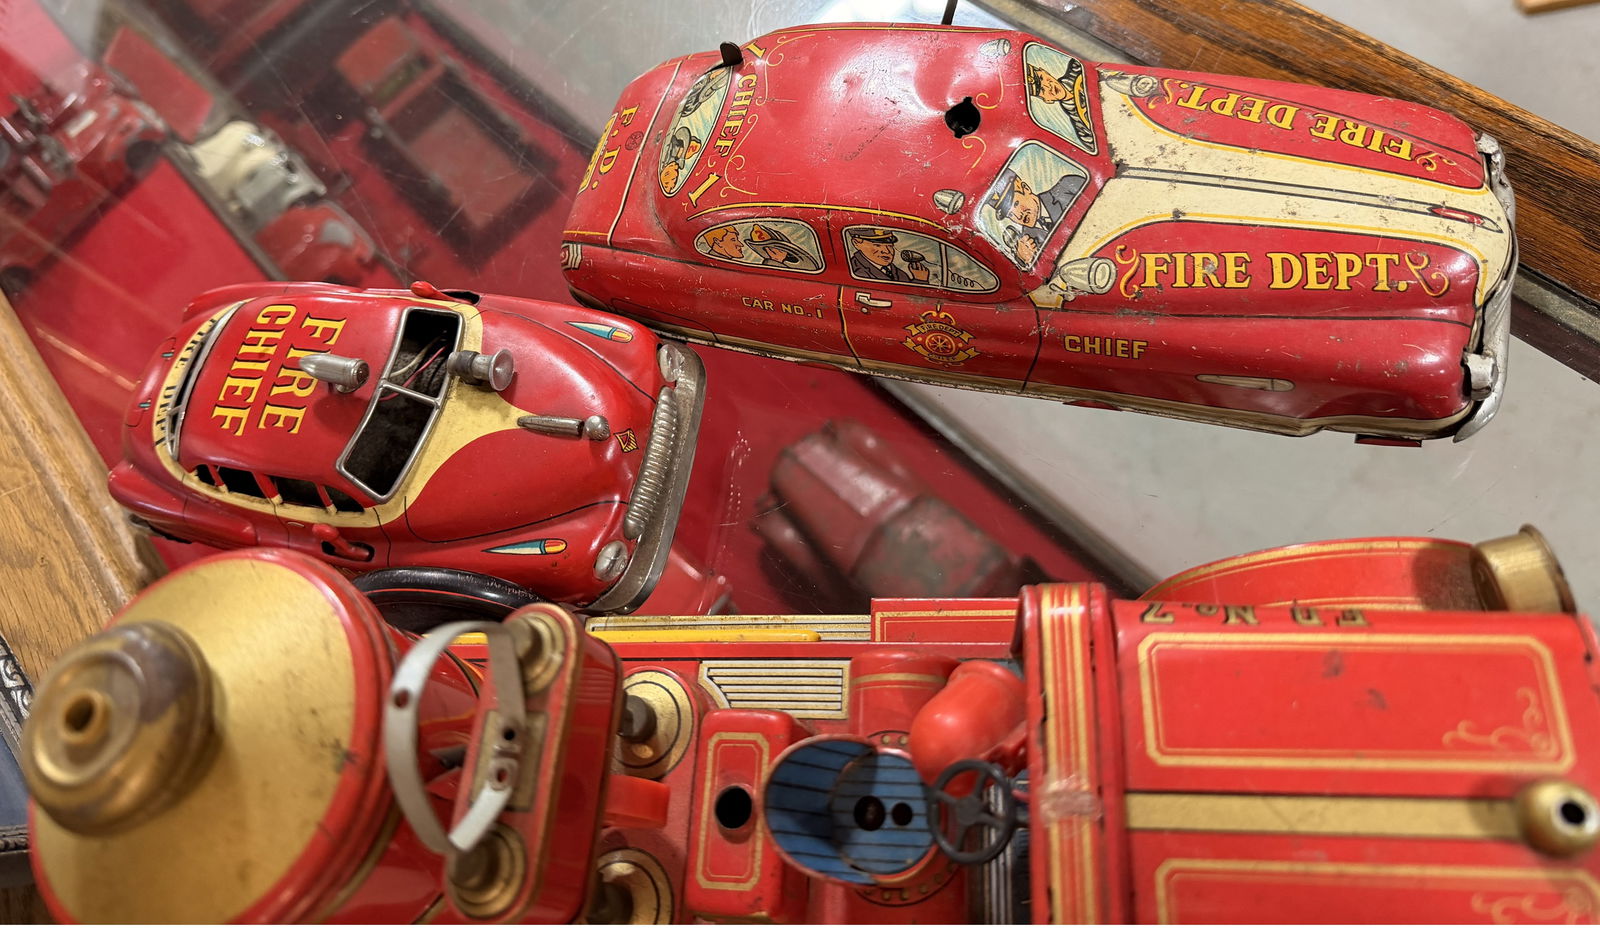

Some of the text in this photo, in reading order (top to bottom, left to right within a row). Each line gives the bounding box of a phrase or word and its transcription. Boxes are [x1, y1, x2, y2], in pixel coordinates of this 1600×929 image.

[713, 72, 759, 158] CHIEF
[1177, 83, 1418, 161] FIRE DEPT.
[687, 171, 723, 208] 1
[1140, 252, 1409, 292] FIRE DEPT.
[741, 296, 775, 312] CAR
[1064, 334, 1149, 360] CHIEF
[211, 303, 348, 437] FIRE CHIEF
